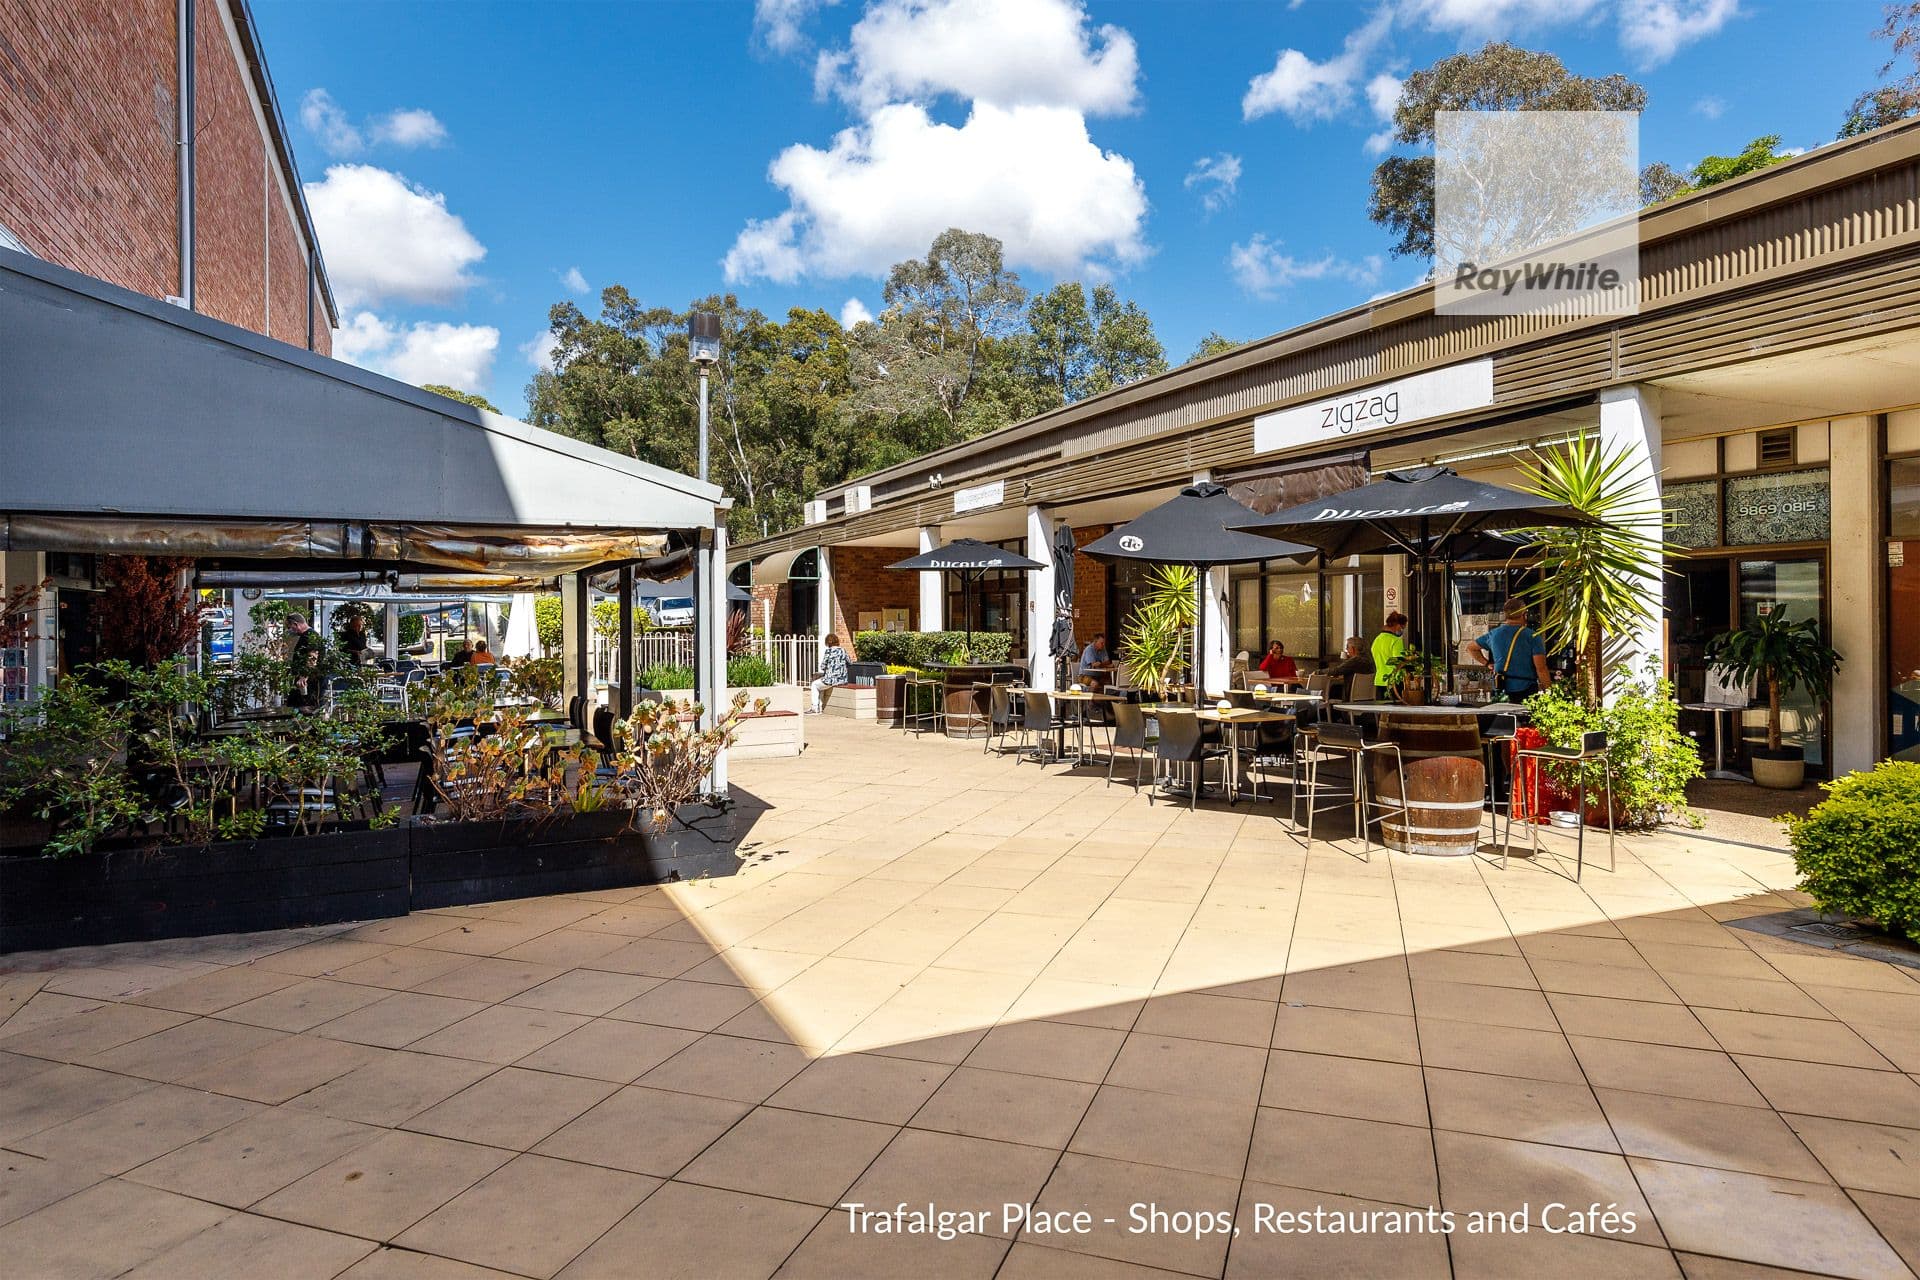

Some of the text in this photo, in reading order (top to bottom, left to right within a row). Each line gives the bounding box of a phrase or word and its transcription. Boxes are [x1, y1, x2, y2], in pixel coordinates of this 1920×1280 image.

[1321, 391, 1399, 434] zigzag
[1739, 500, 1817, 517] 9869 0815
